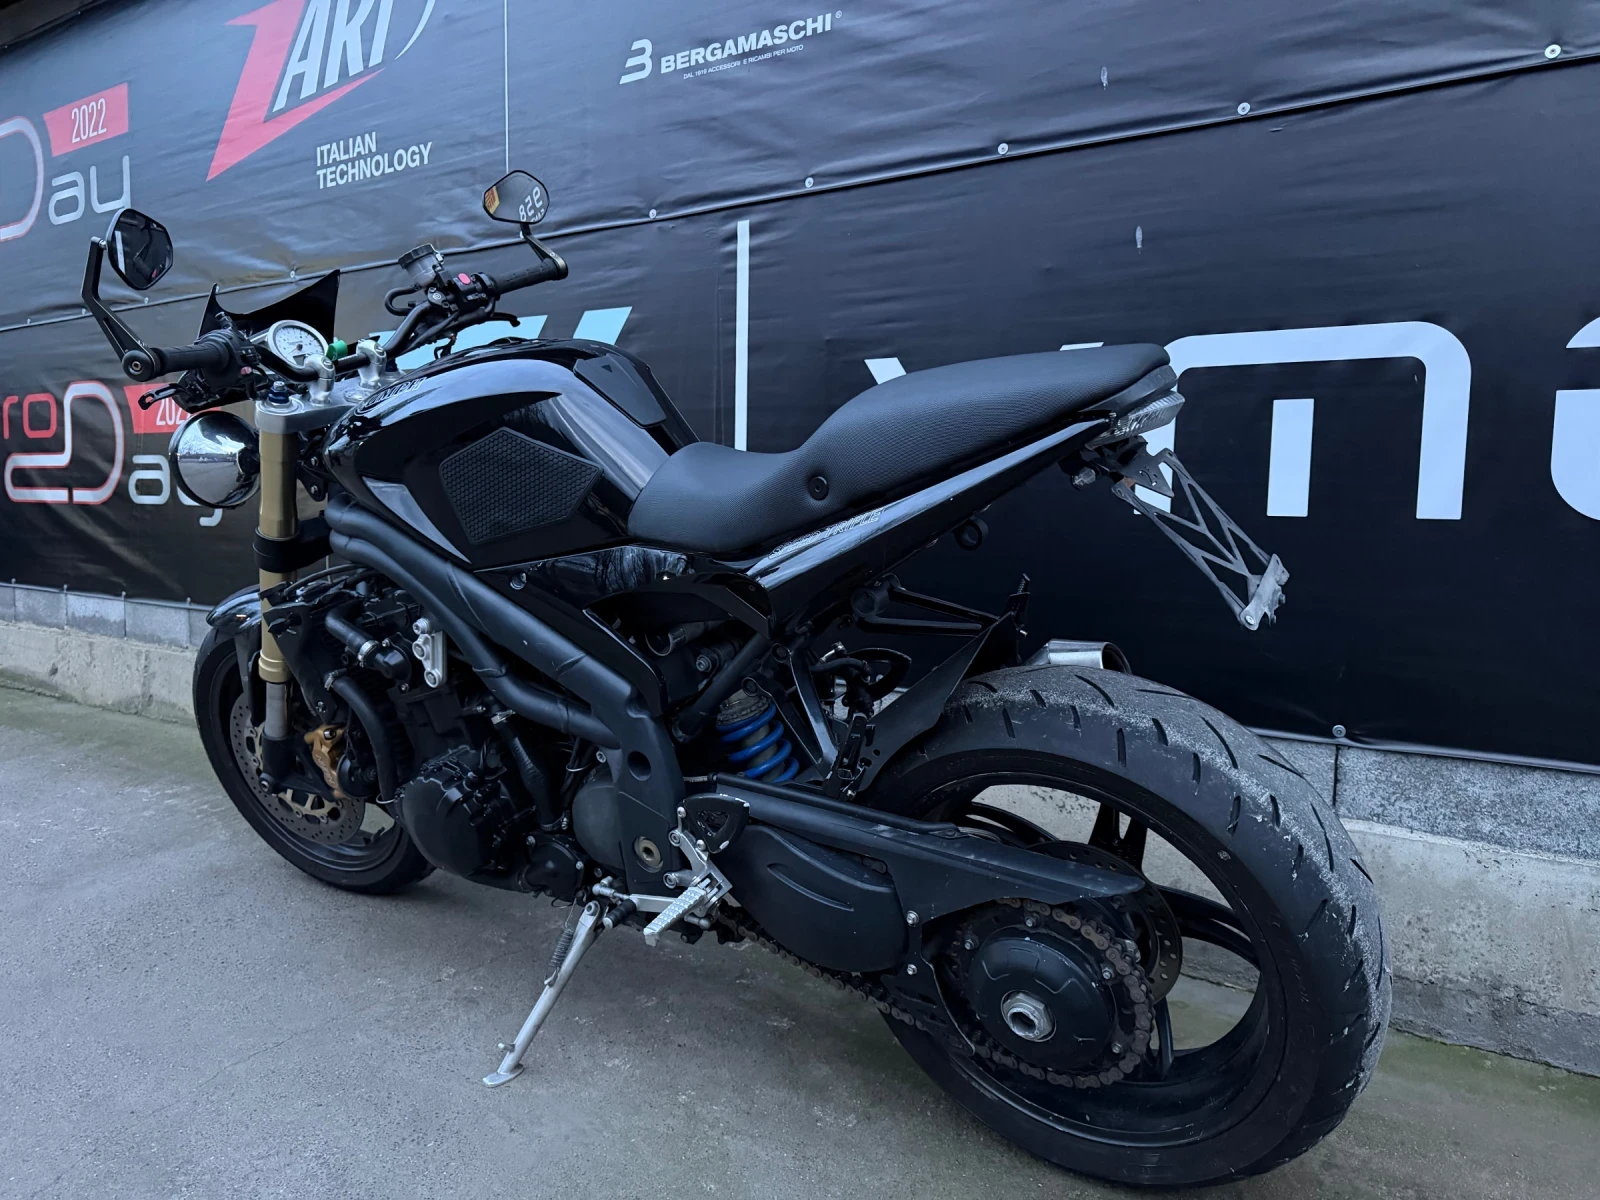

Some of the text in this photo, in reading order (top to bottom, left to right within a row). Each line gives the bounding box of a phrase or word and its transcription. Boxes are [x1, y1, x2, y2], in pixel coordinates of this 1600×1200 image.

[660, 13, 832, 74] BERGAMASCHI
[708, 60, 741, 73] ACCESSORI
[748, 52, 773, 65] RICAMBI
[773, 47, 786, 57] PER
[786, 44, 804, 54] MOTO
[71, 97, 107, 144] 2022
[316, 131, 377, 167] ITALIAN
[316, 141, 432, 190] TECHNOLOGY
[156, 397, 192, 426] 202
